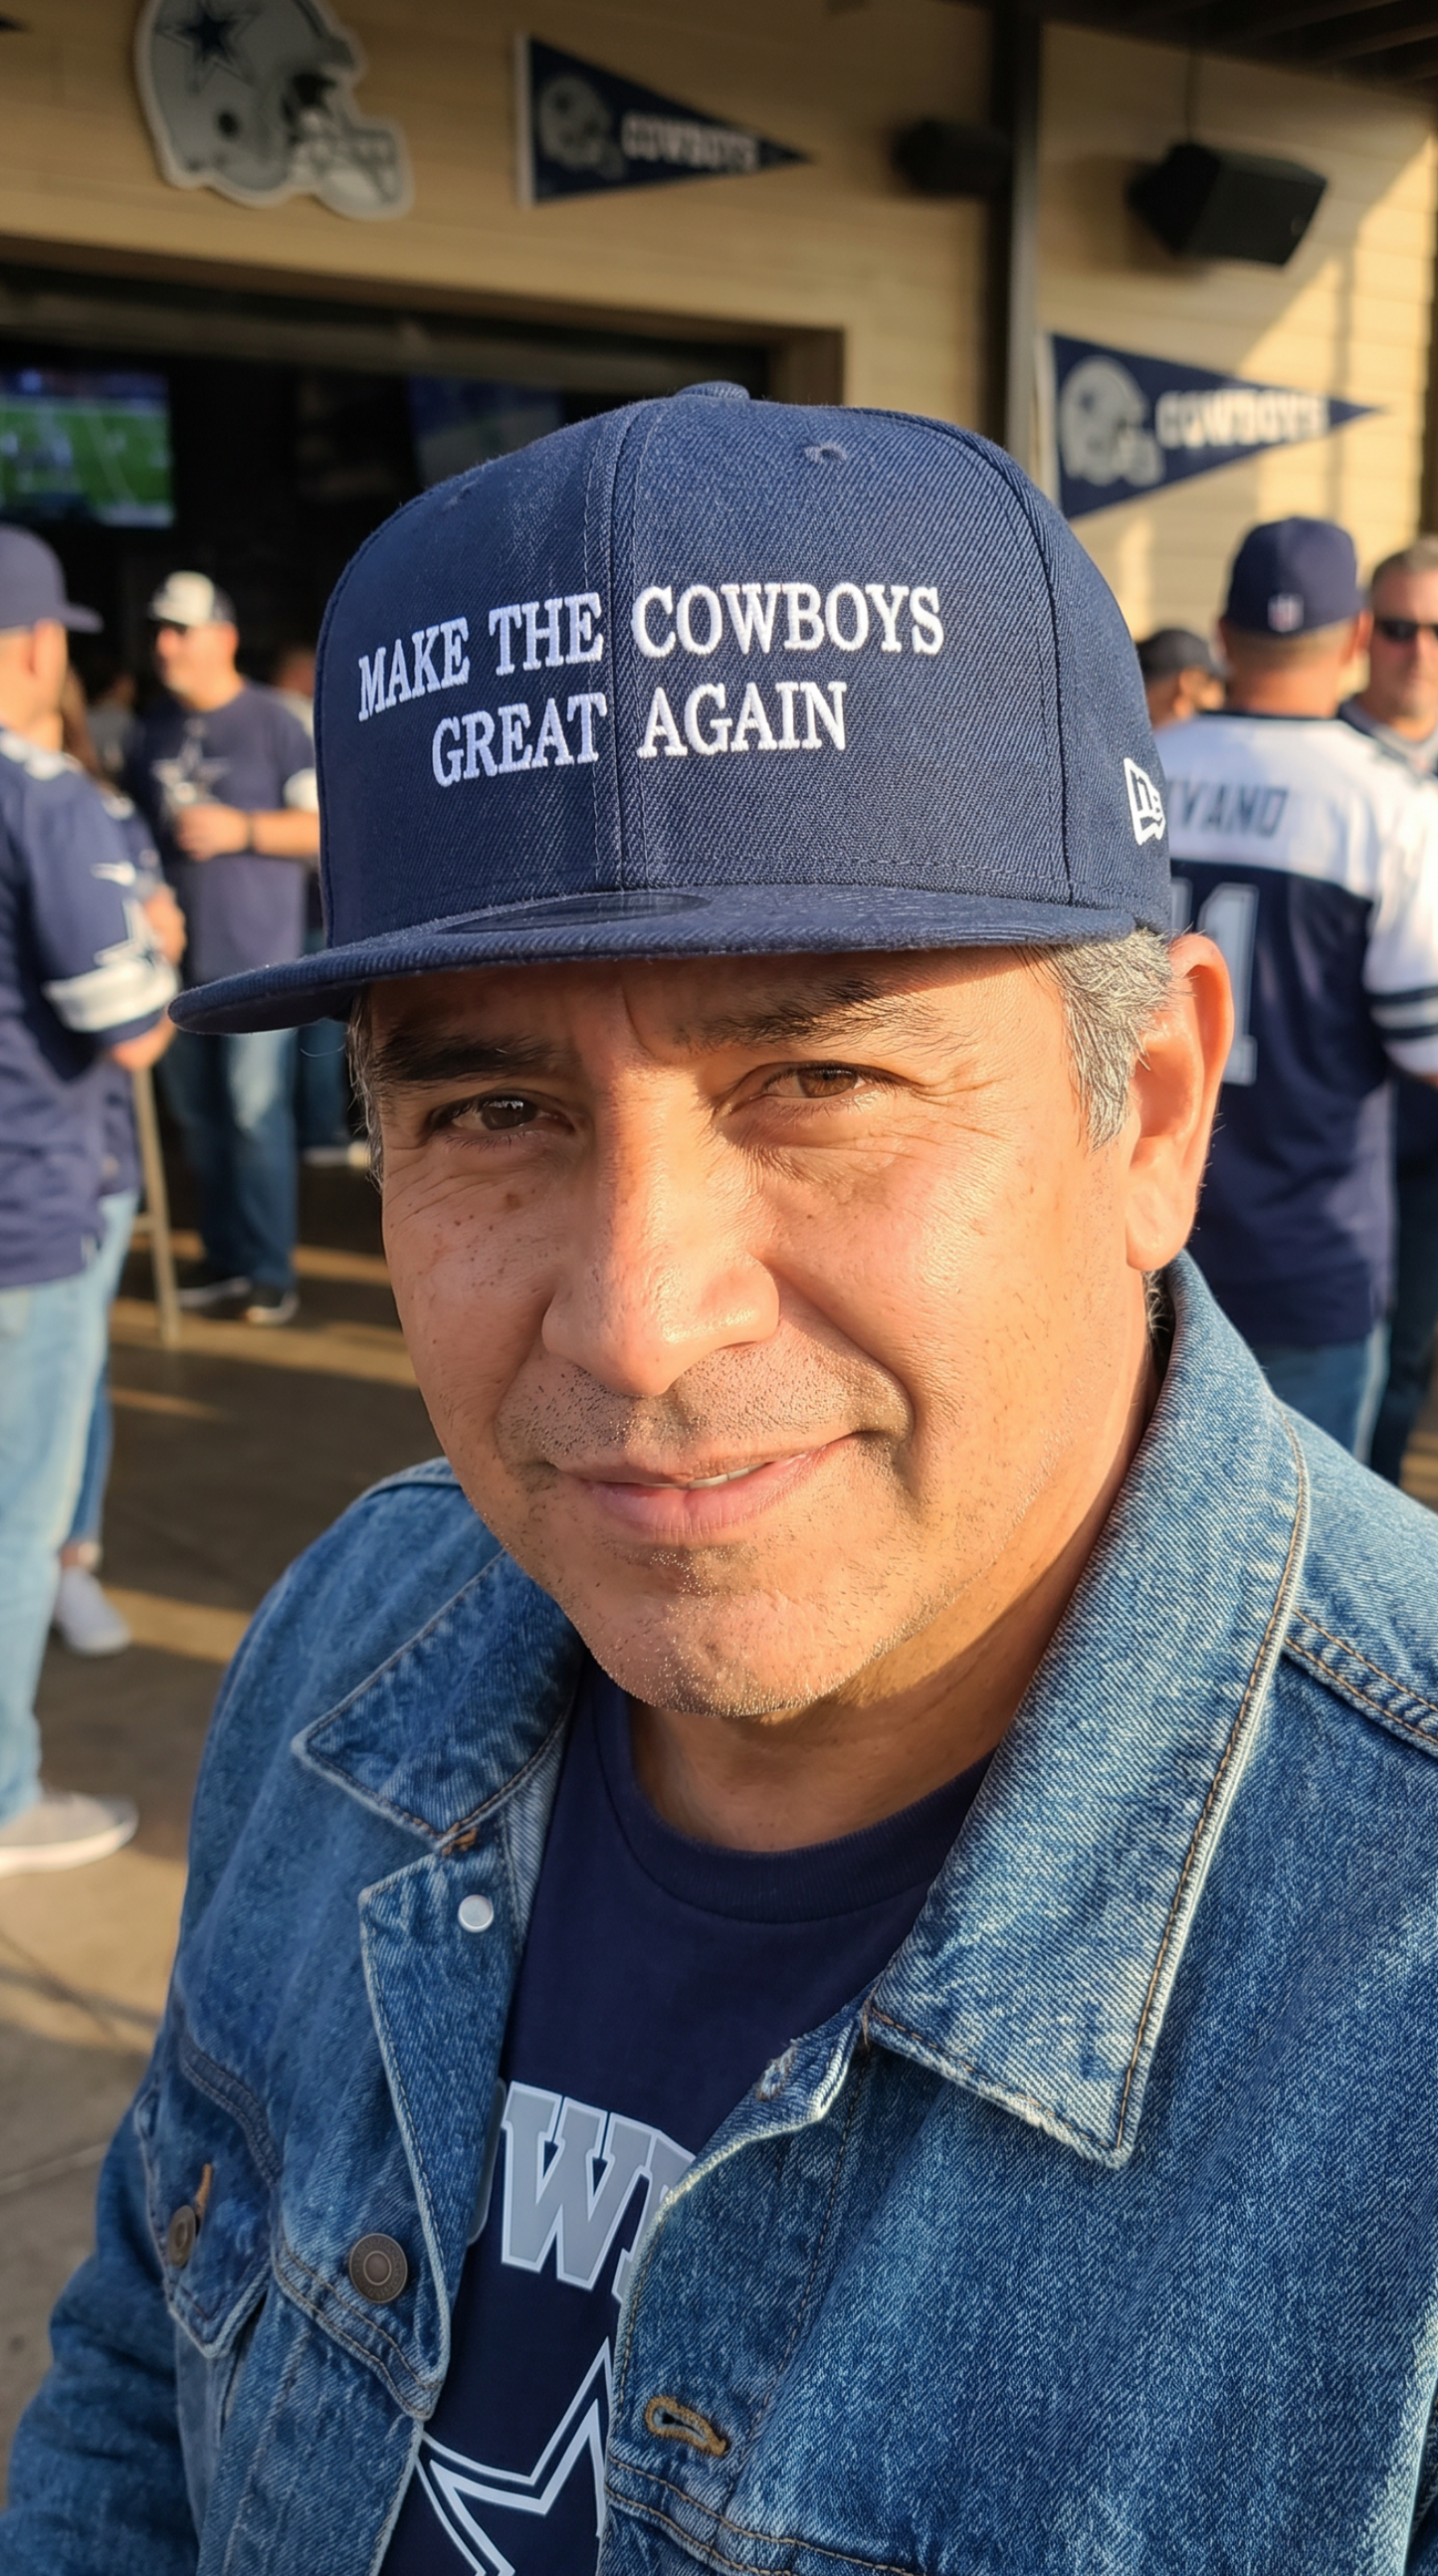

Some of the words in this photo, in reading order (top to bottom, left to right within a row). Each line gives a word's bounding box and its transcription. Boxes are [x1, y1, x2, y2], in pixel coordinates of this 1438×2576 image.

[357, 617, 471, 721] MAKE
[488, 591, 604, 677] THE
[630, 581, 945, 659] COWBOYS
[431, 692, 608, 787] GREAT
[636, 680, 849, 759] AGAIN
